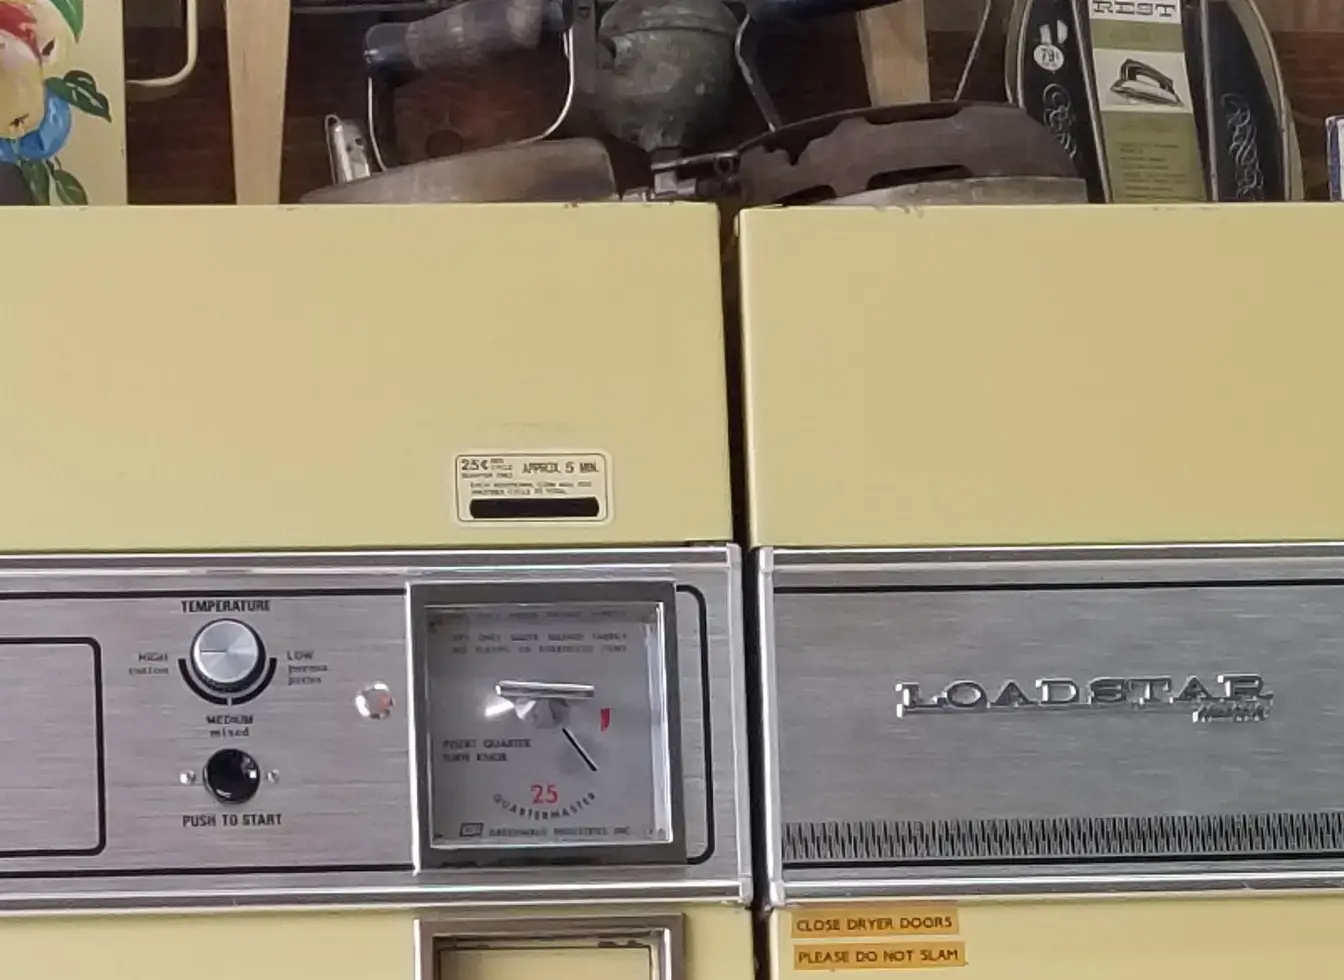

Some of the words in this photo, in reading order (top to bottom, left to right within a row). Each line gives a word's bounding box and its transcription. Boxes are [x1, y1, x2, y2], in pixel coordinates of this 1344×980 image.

[565, 462, 575, 474] 5
[181, 599, 271, 612] TEMPERATURE
[896, 674, 1274, 718] LOADSTAR
[530, 783, 559, 804] 25
[493, 792, 597, 821] QUARTERMASTER
[182, 815, 217, 828] PUSH
[222, 814, 239, 827] TO
[242, 813, 283, 827] START
[796, 918, 840, 932] CLOSE
[847, 916, 893, 930] DRYER
[900, 915, 953, 929] DOORS
[798, 951, 849, 964] PLEASE
[855, 950, 878, 963] DO
[883, 949, 913, 962] NOT
[920, 948, 958, 961] SLAM
